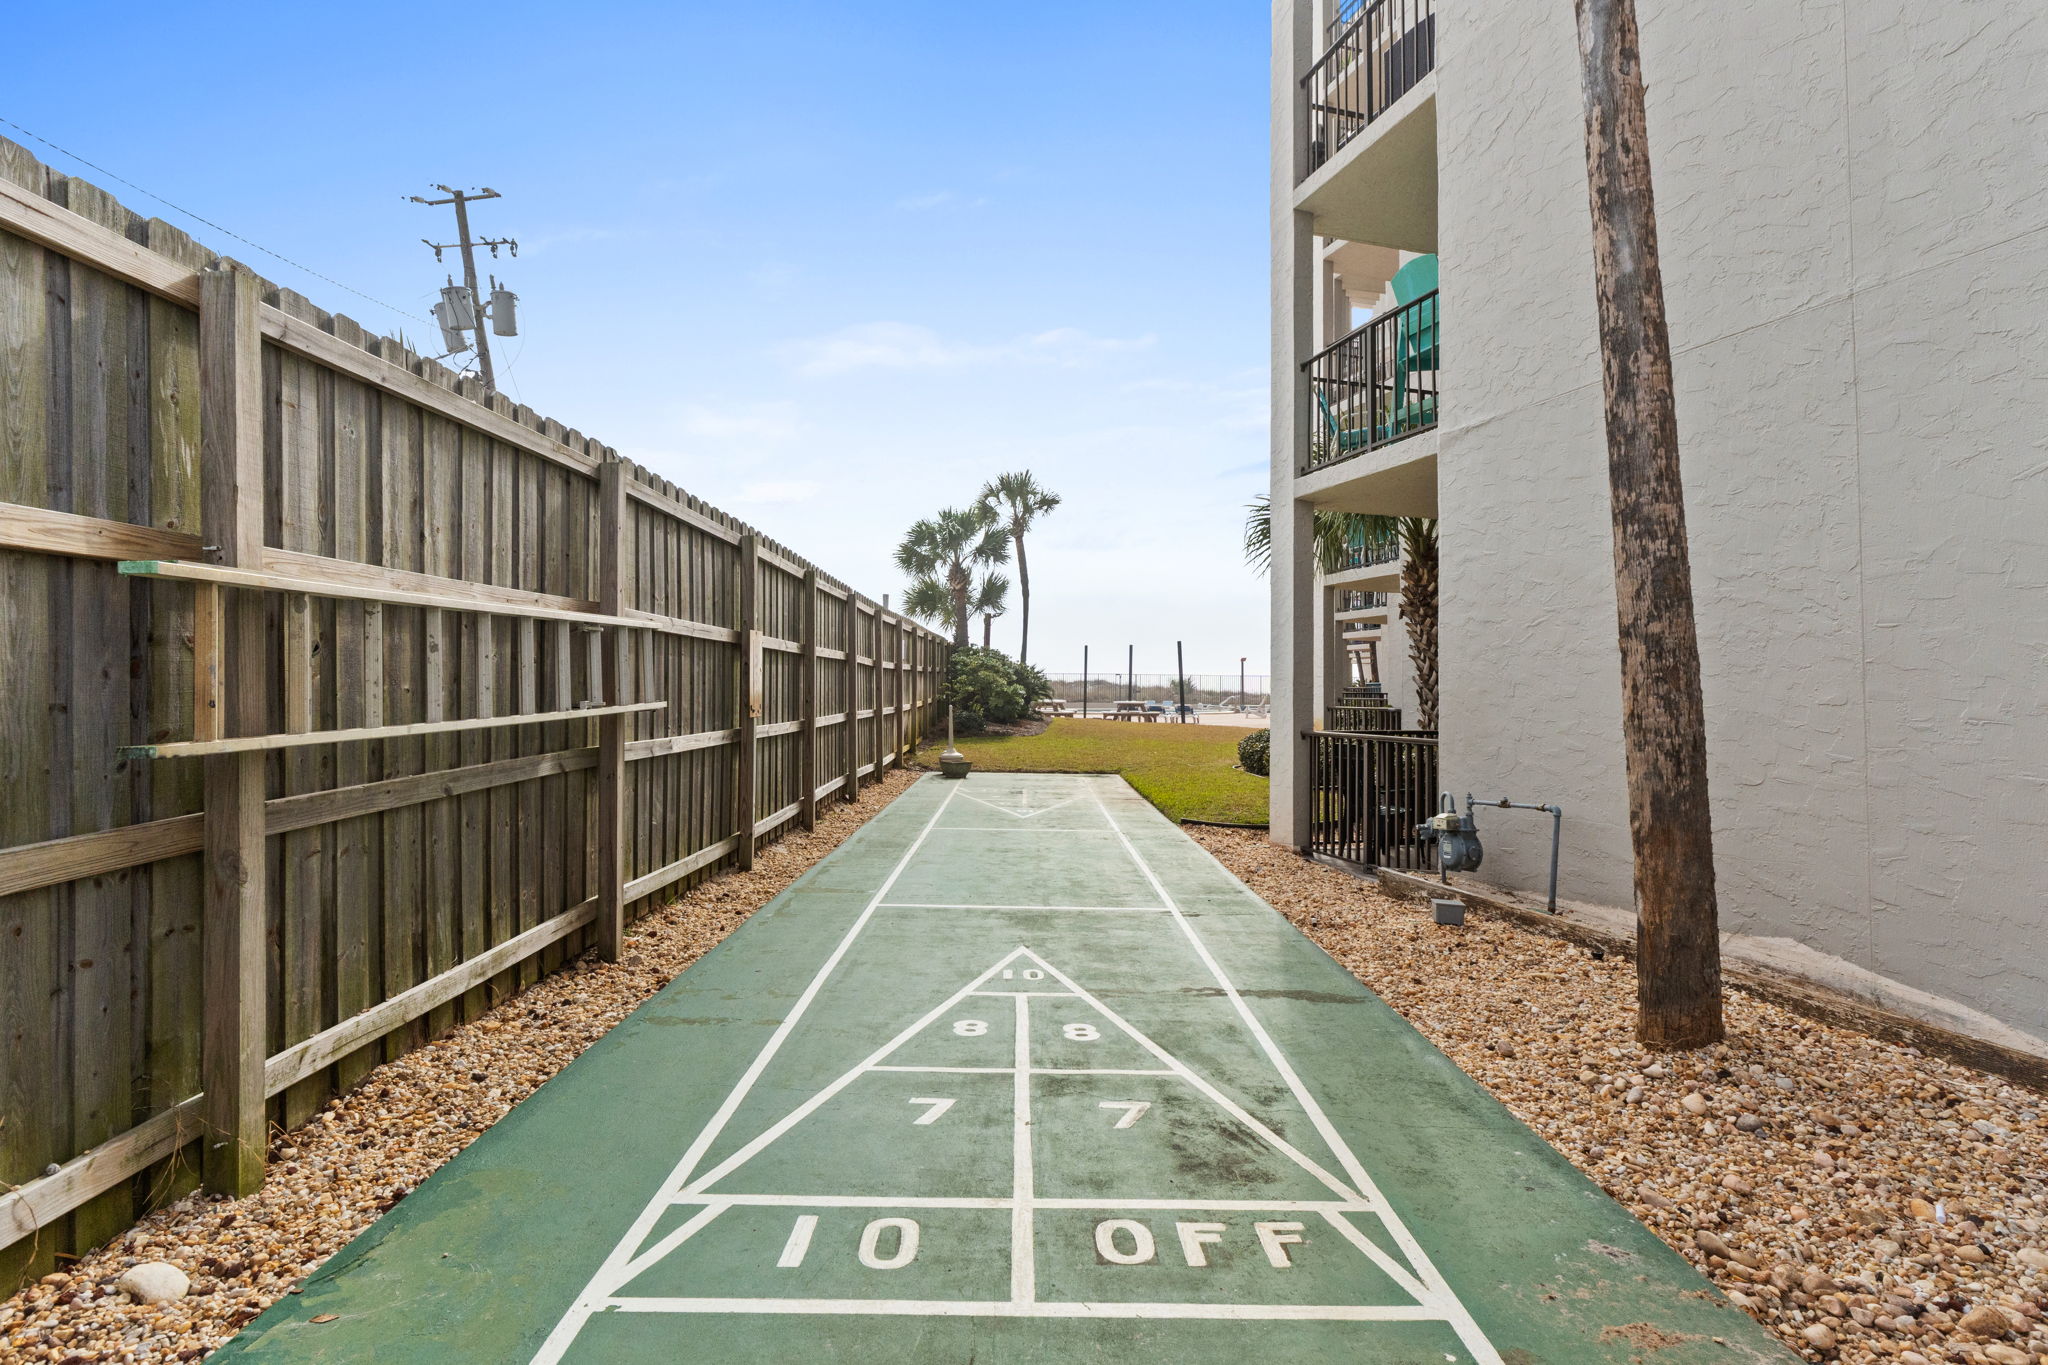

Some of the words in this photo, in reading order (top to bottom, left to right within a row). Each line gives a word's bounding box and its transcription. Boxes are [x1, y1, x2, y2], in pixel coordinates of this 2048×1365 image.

[1002, 970, 1044, 981] 10
[952, 1019, 989, 1037] 8
[1062, 1022, 1102, 1042] 8
[908, 1097, 958, 1126] 7
[1098, 1100, 1152, 1130] 7
[776, 1214, 920, 1270] 10
[1095, 1218, 1305, 1268] OFF
